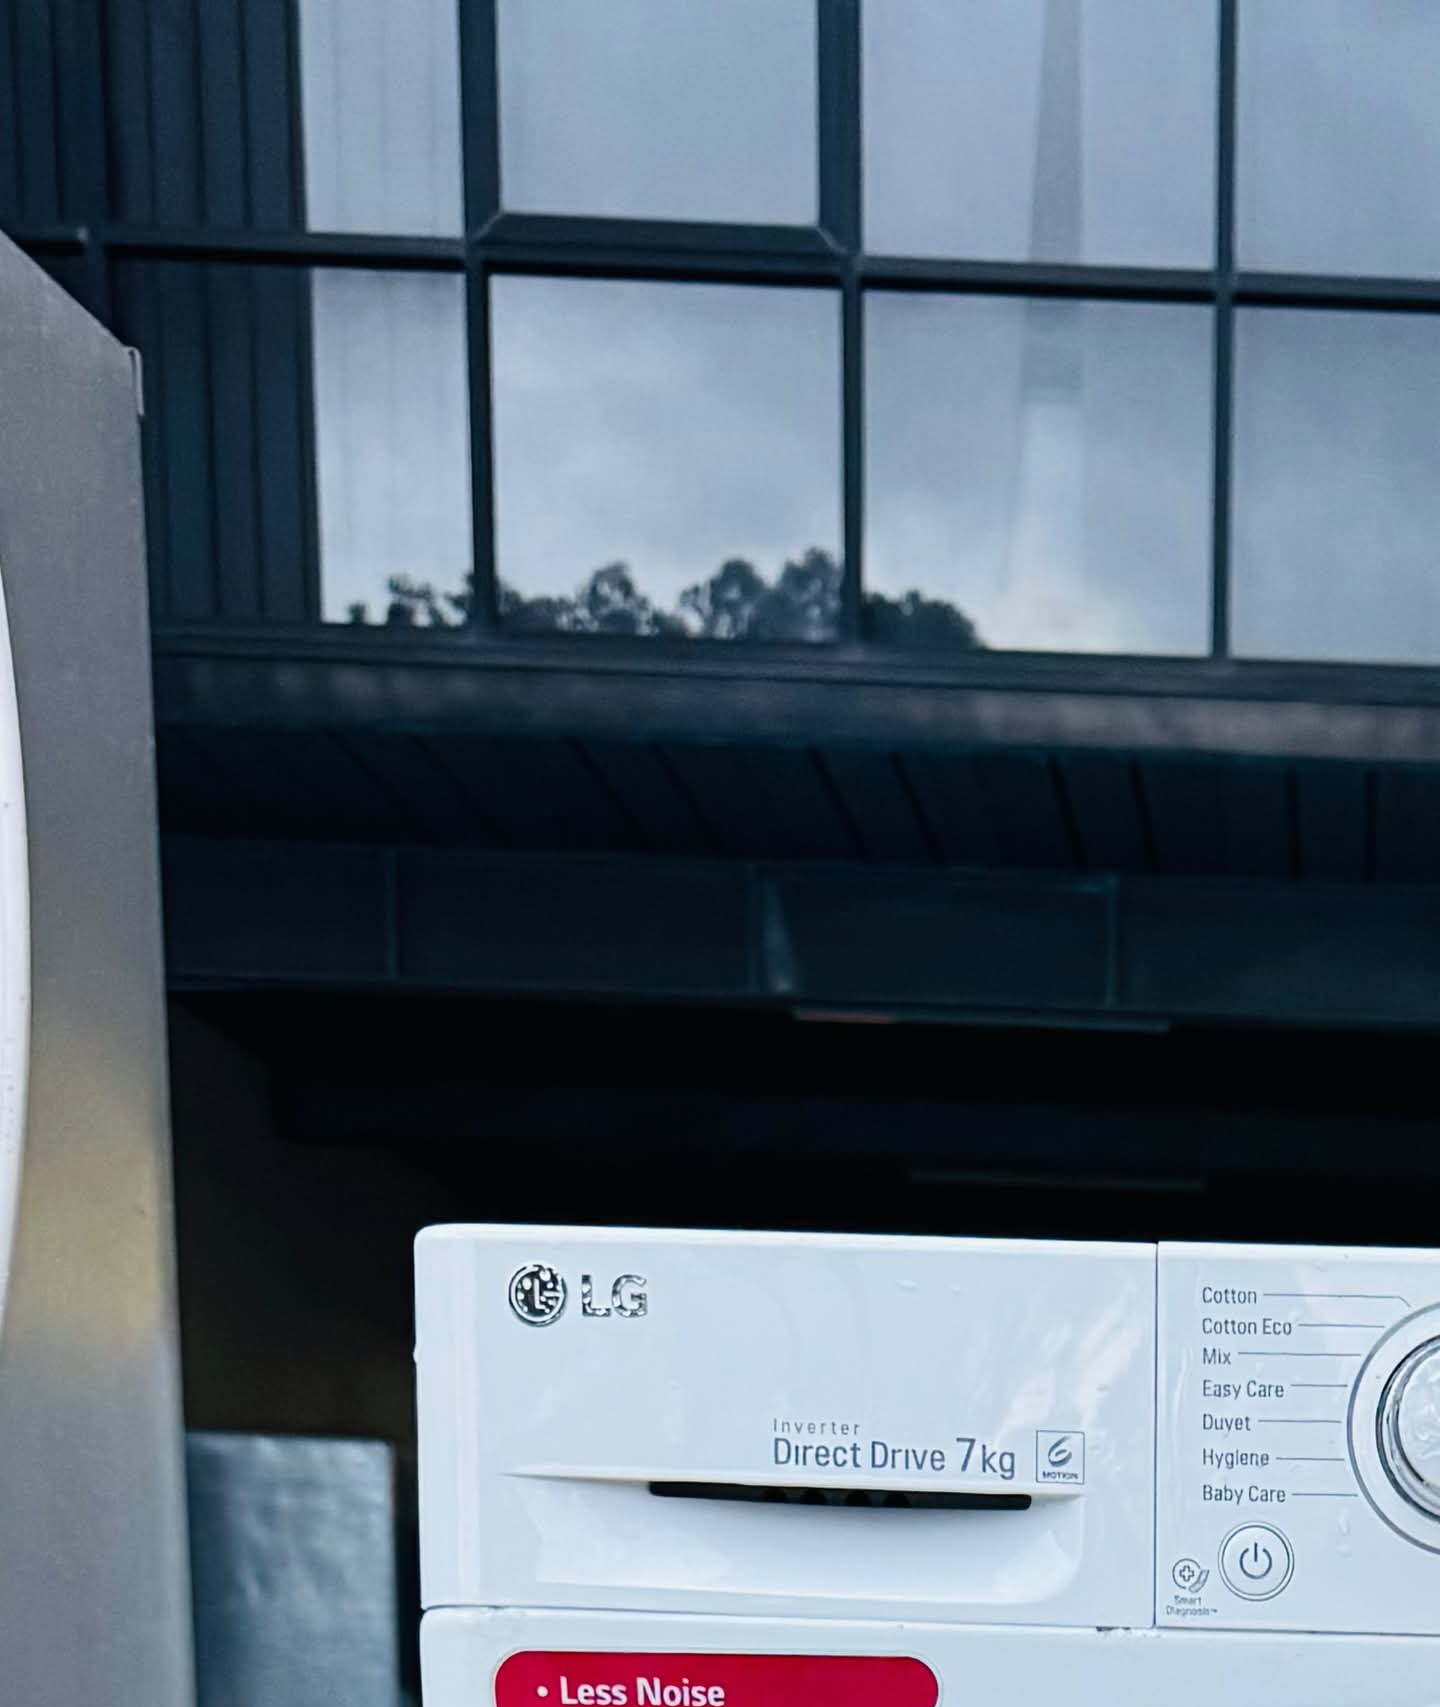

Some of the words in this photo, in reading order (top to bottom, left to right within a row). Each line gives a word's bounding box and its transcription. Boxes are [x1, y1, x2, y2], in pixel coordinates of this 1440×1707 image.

[581, 1274, 648, 1318] LG
[1202, 1286, 1258, 1305] Cotton
[1202, 1317, 1256, 1336] Cotton
[1261, 1318, 1292, 1336] Eco
[1203, 1348, 1232, 1365] Mix
[1203, 1380, 1242, 1400] Easy
[1246, 1381, 1285, 1399] Care
[773, 1418, 860, 1436] Inverter
[1202, 1413, 1251, 1433] Duvet
[774, 1438, 861, 1469] Direct
[870, 1441, 946, 1472] Drive
[1202, 1448, 1270, 1470] Hygiene
[1202, 1484, 1242, 1505] Baby
[1246, 1485, 1286, 1504] Care
[560, 1676, 627, 1706] Less
[636, 1677, 725, 1707] Noise
